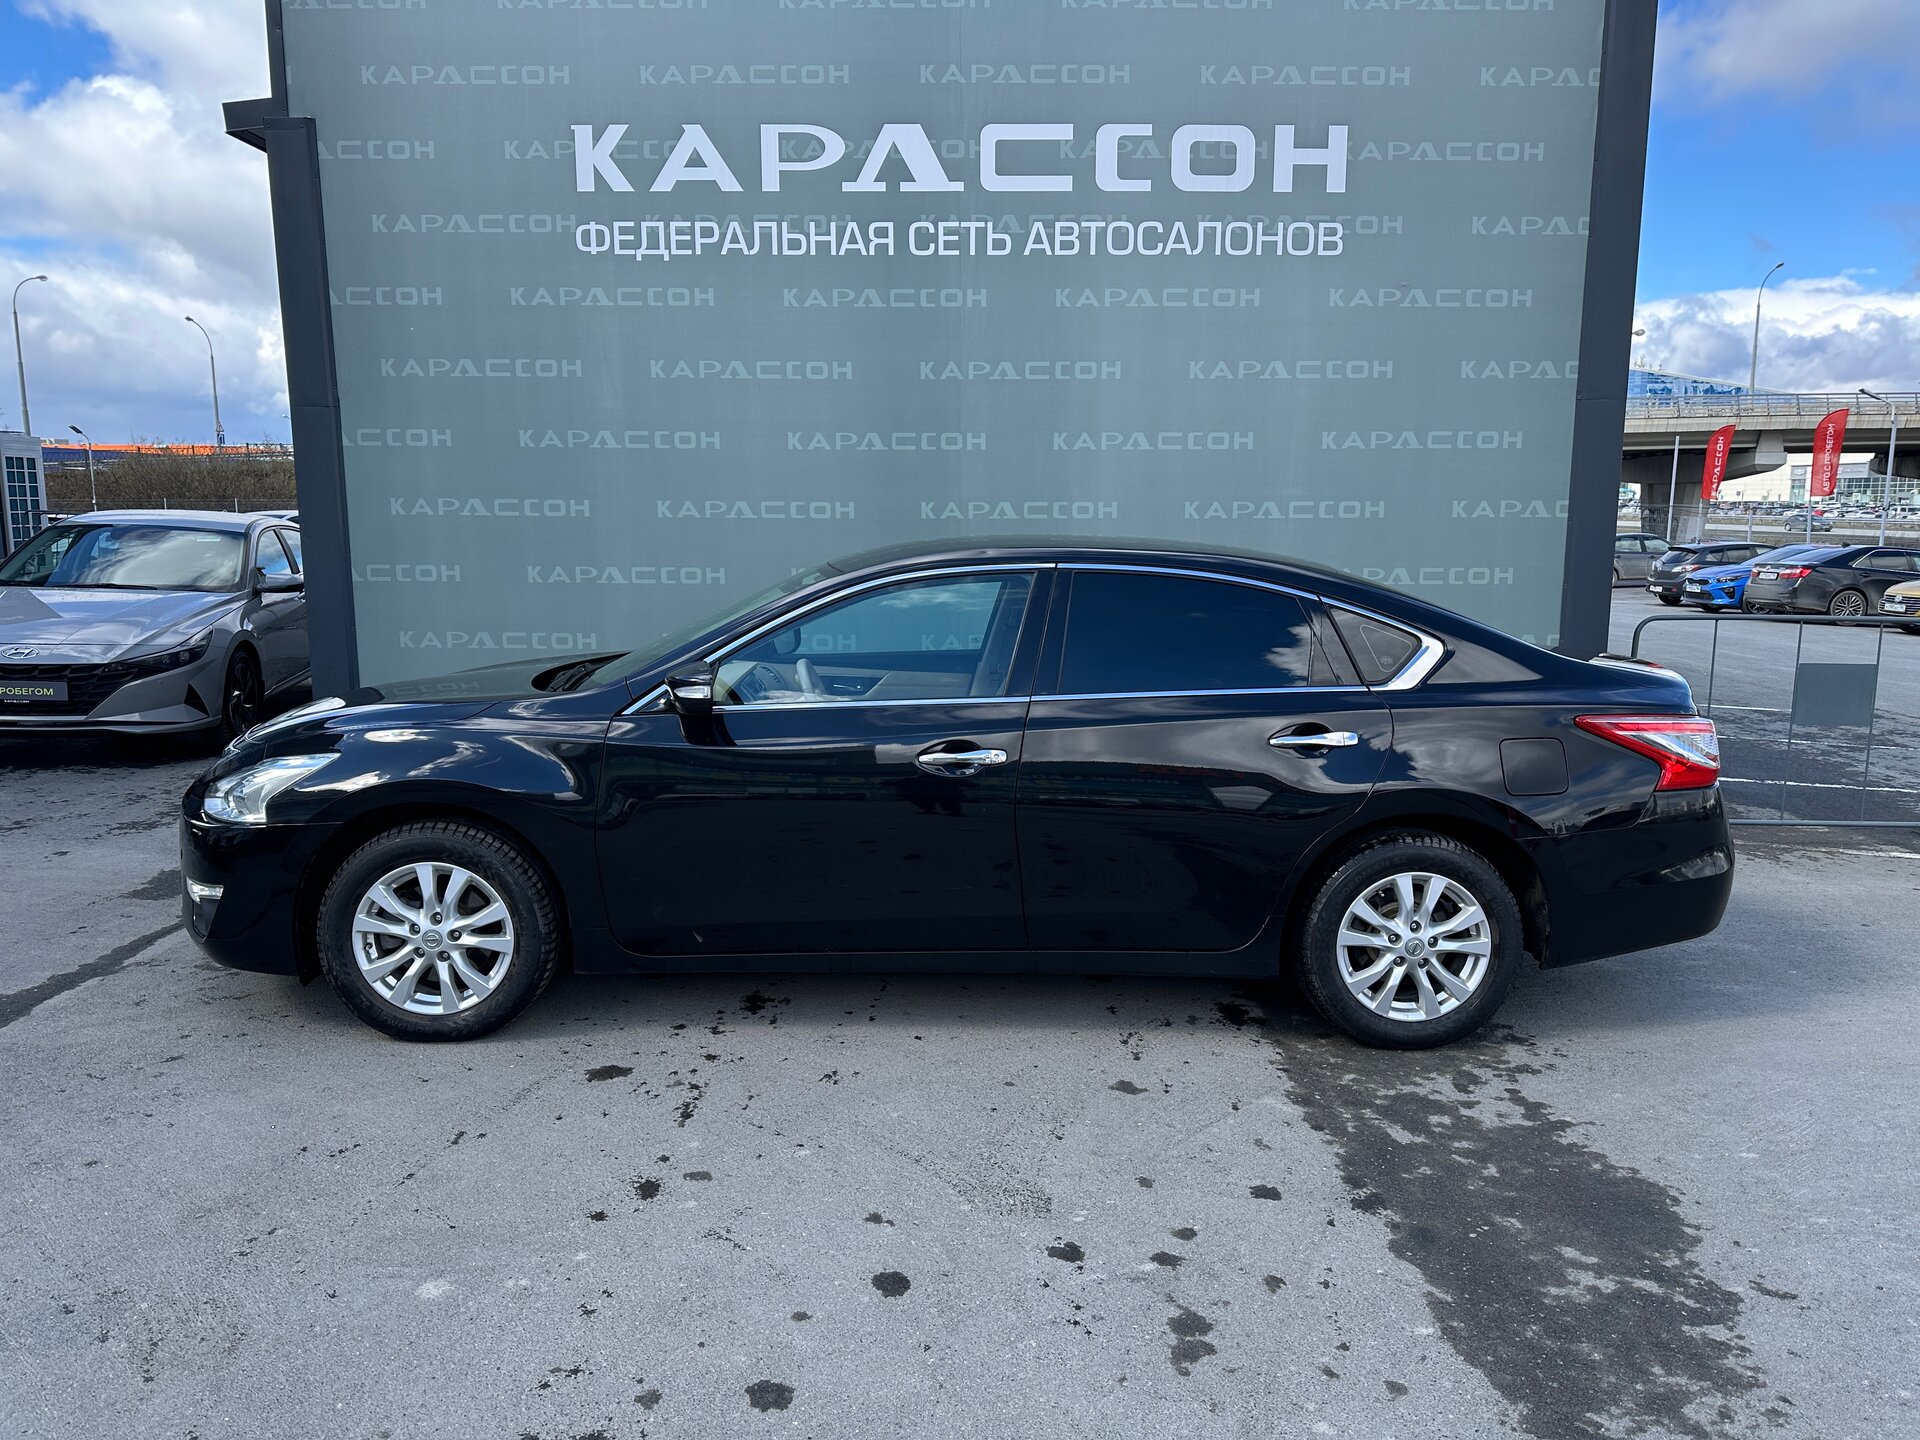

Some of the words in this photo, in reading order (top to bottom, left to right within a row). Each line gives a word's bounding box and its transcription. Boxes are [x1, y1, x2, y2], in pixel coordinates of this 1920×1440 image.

[575, 221, 894, 261] ФЕДЕРАЛЬНАЯ
[908, 221, 1012, 256] СЕТЬ
[1023, 221, 1344, 257] АВТОСАЛОНОВ
[1825, 423, 1835, 463] ПРОБЕГОМ
[1822, 472, 1831, 492] АВТО
